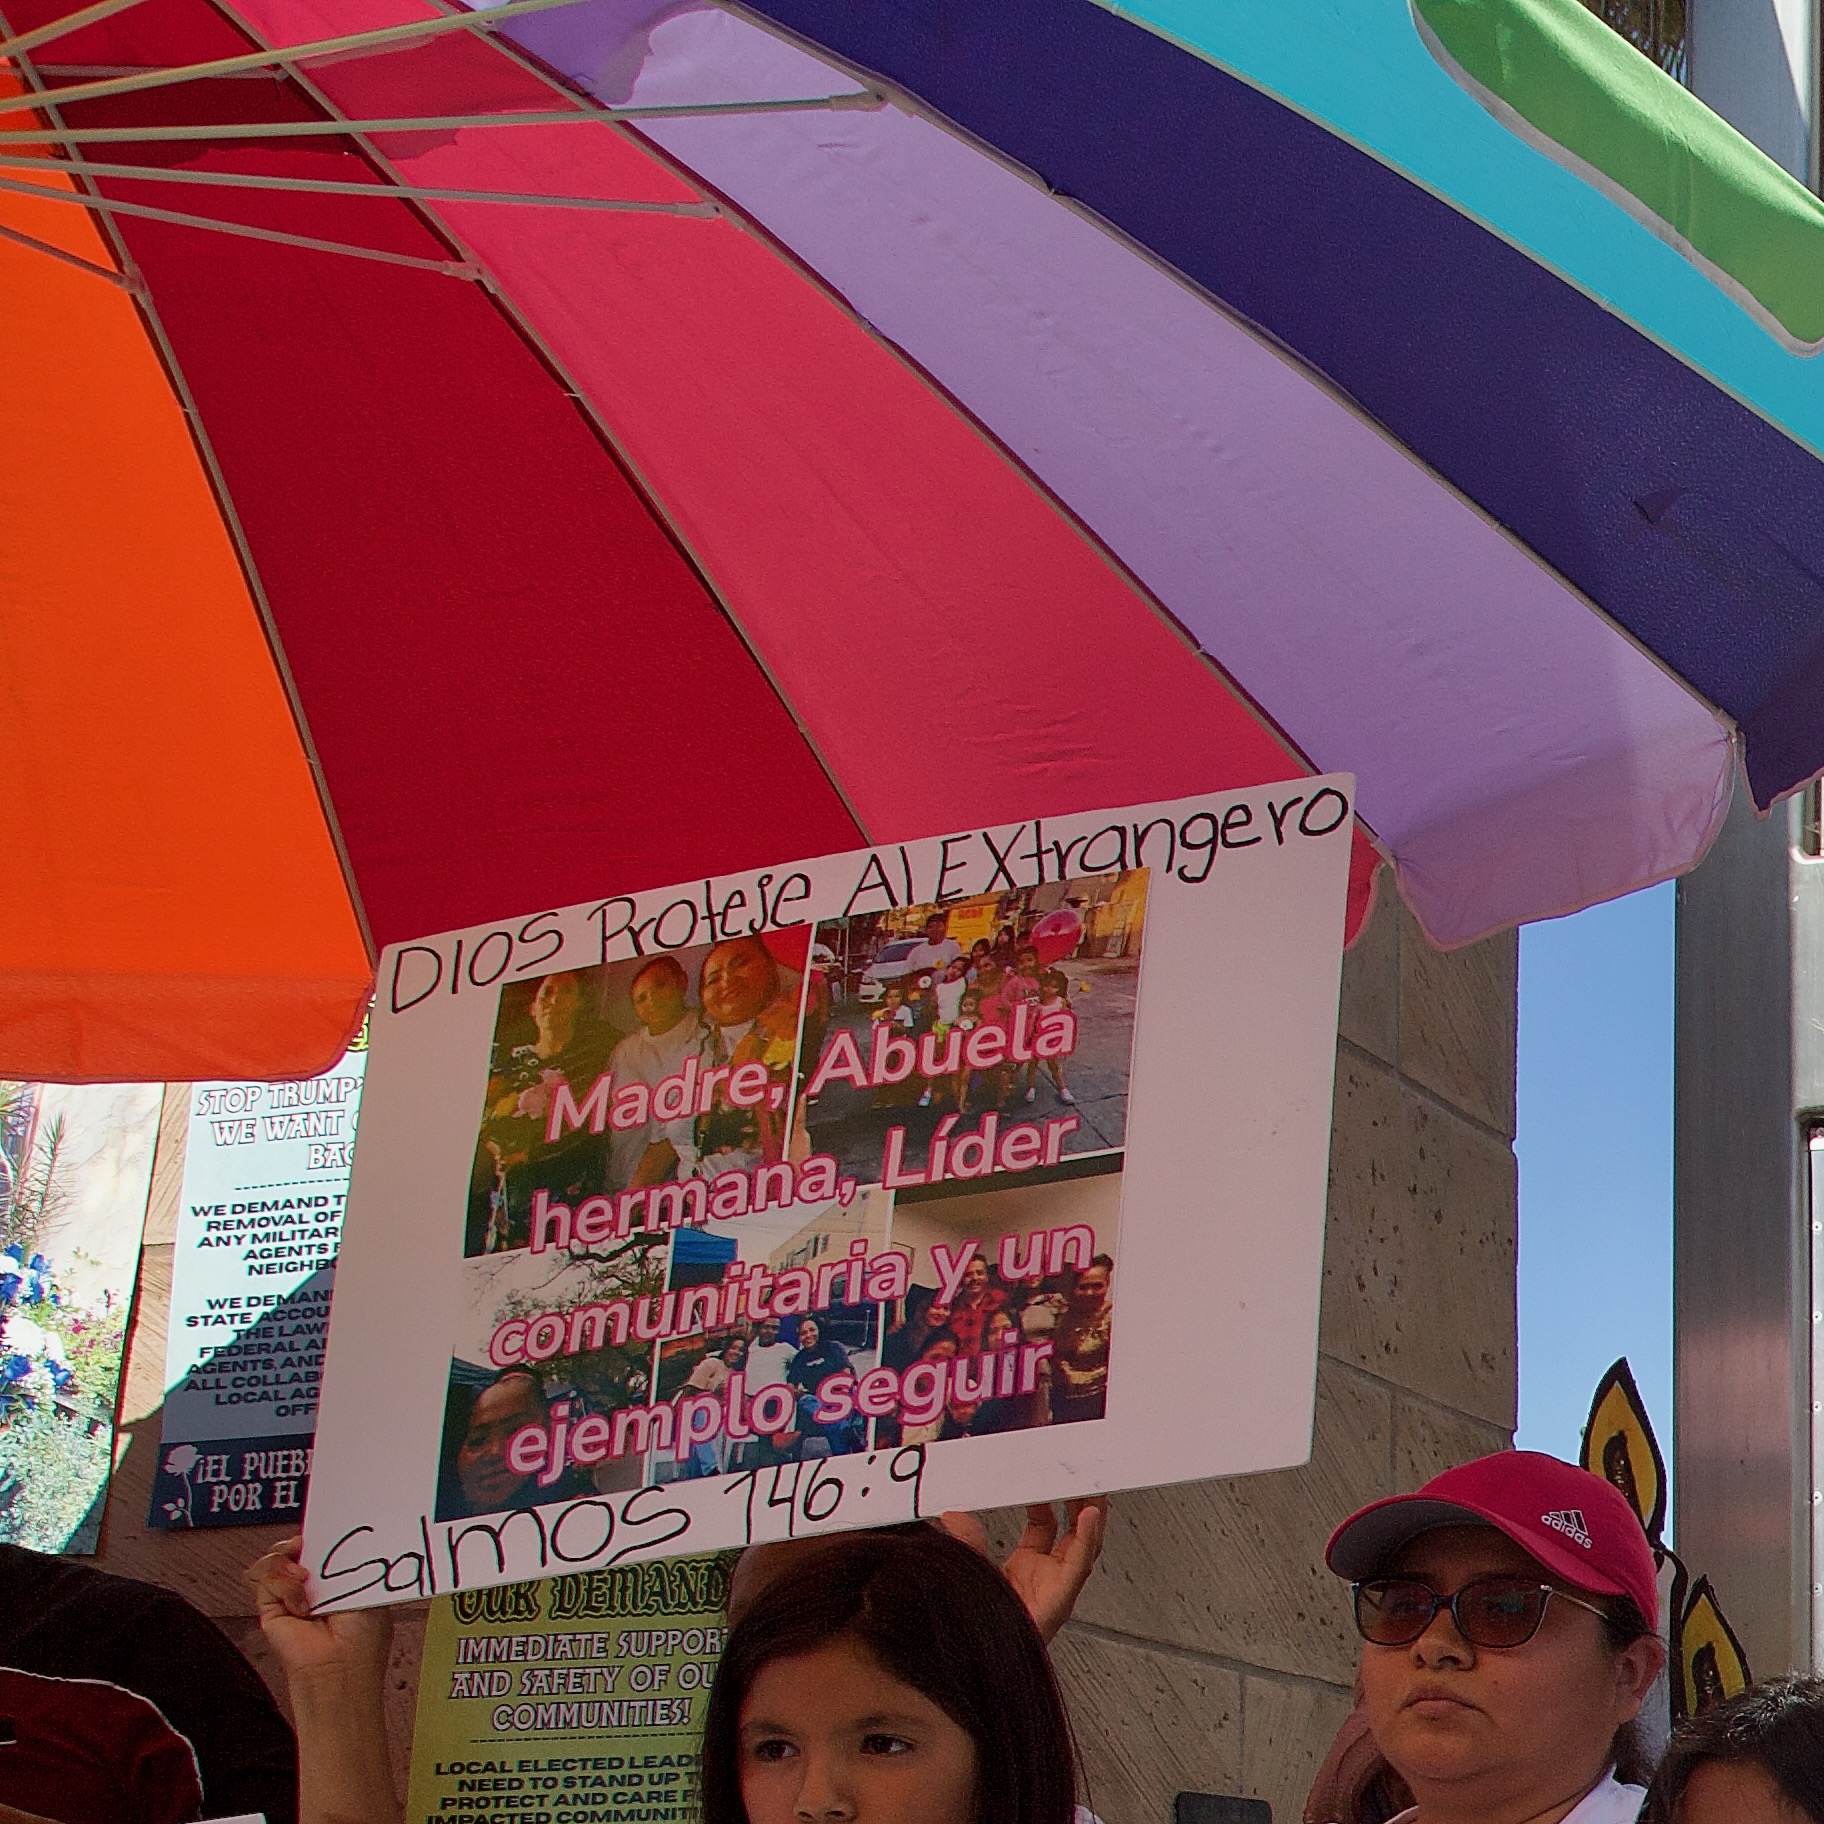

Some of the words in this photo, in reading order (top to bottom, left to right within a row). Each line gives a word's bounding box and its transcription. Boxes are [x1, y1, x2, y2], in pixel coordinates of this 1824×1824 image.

[587, 872, 812, 963] Proteje
[543, 1055, 785, 1143] Madre,
[805, 1002, 1078, 1099] Abuela
[195, 1085, 262, 1116] STOP
[210, 1117, 257, 1146] WE
[262, 1109, 346, 1142] WANT
[530, 1154, 857, 1254] hermana,
[881, 1111, 1081, 1190] Líder
[190, 1205, 226, 1216] WE
[231, 1196, 330, 1214] DEMAND
[206, 1212, 311, 1232] REMOVAL
[314, 1210, 342, 1223] OF
[196, 1234, 246, 1248] ANY
[242, 1243, 329, 1261] AGENTS
[207, 1298, 241, 1311] WE
[490, 1239, 909, 1366] comunitaria
[931, 1239, 977, 1304] y
[1000, 1224, 1096, 1281] un
[186, 1312, 252, 1328] STATE
[233, 1326, 275, 1340] THE
[199, 1342, 302, 1358] FEDERAL
[187, 1360, 277, 1375] AGENTS,
[183, 1378, 228, 1392] ALL
[214, 1391, 287, 1405] LOCAL
[507, 1375, 797, 1486] ejemplo
[815, 1329, 1054, 1426] seguir
[195, 1453, 232, 1485] ¡EL
[210, 1483, 263, 1513] POR
[271, 1480, 300, 1509] EL
[309, 1485, 691, 1614] Salmos
[723, 1442, 928, 1545] 146:9
[1541, 1514, 1593, 1550] adidas
[456, 1632, 609, 1665] IMMEDIATE
[449, 1671, 511, 1699] AND
[518, 1667, 622, 1696] SAFETY
[629, 1664, 670, 1692] OF
[492, 1698, 691, 1731] COMMUNITIES!
[434, 1760, 512, 1776] LOCAL
[520, 1756, 624, 1773] ELECTED
[458, 1778, 524, 1792] NEED
[527, 1775, 557, 1790] TO
[562, 1773, 645, 1789] STAND
[649, 1773, 680, 1786] UP
[440, 1795, 549, 1810] PROTECT
[553, 1793, 608, 1806] AND
[612, 1791, 678, 1804] CARE
